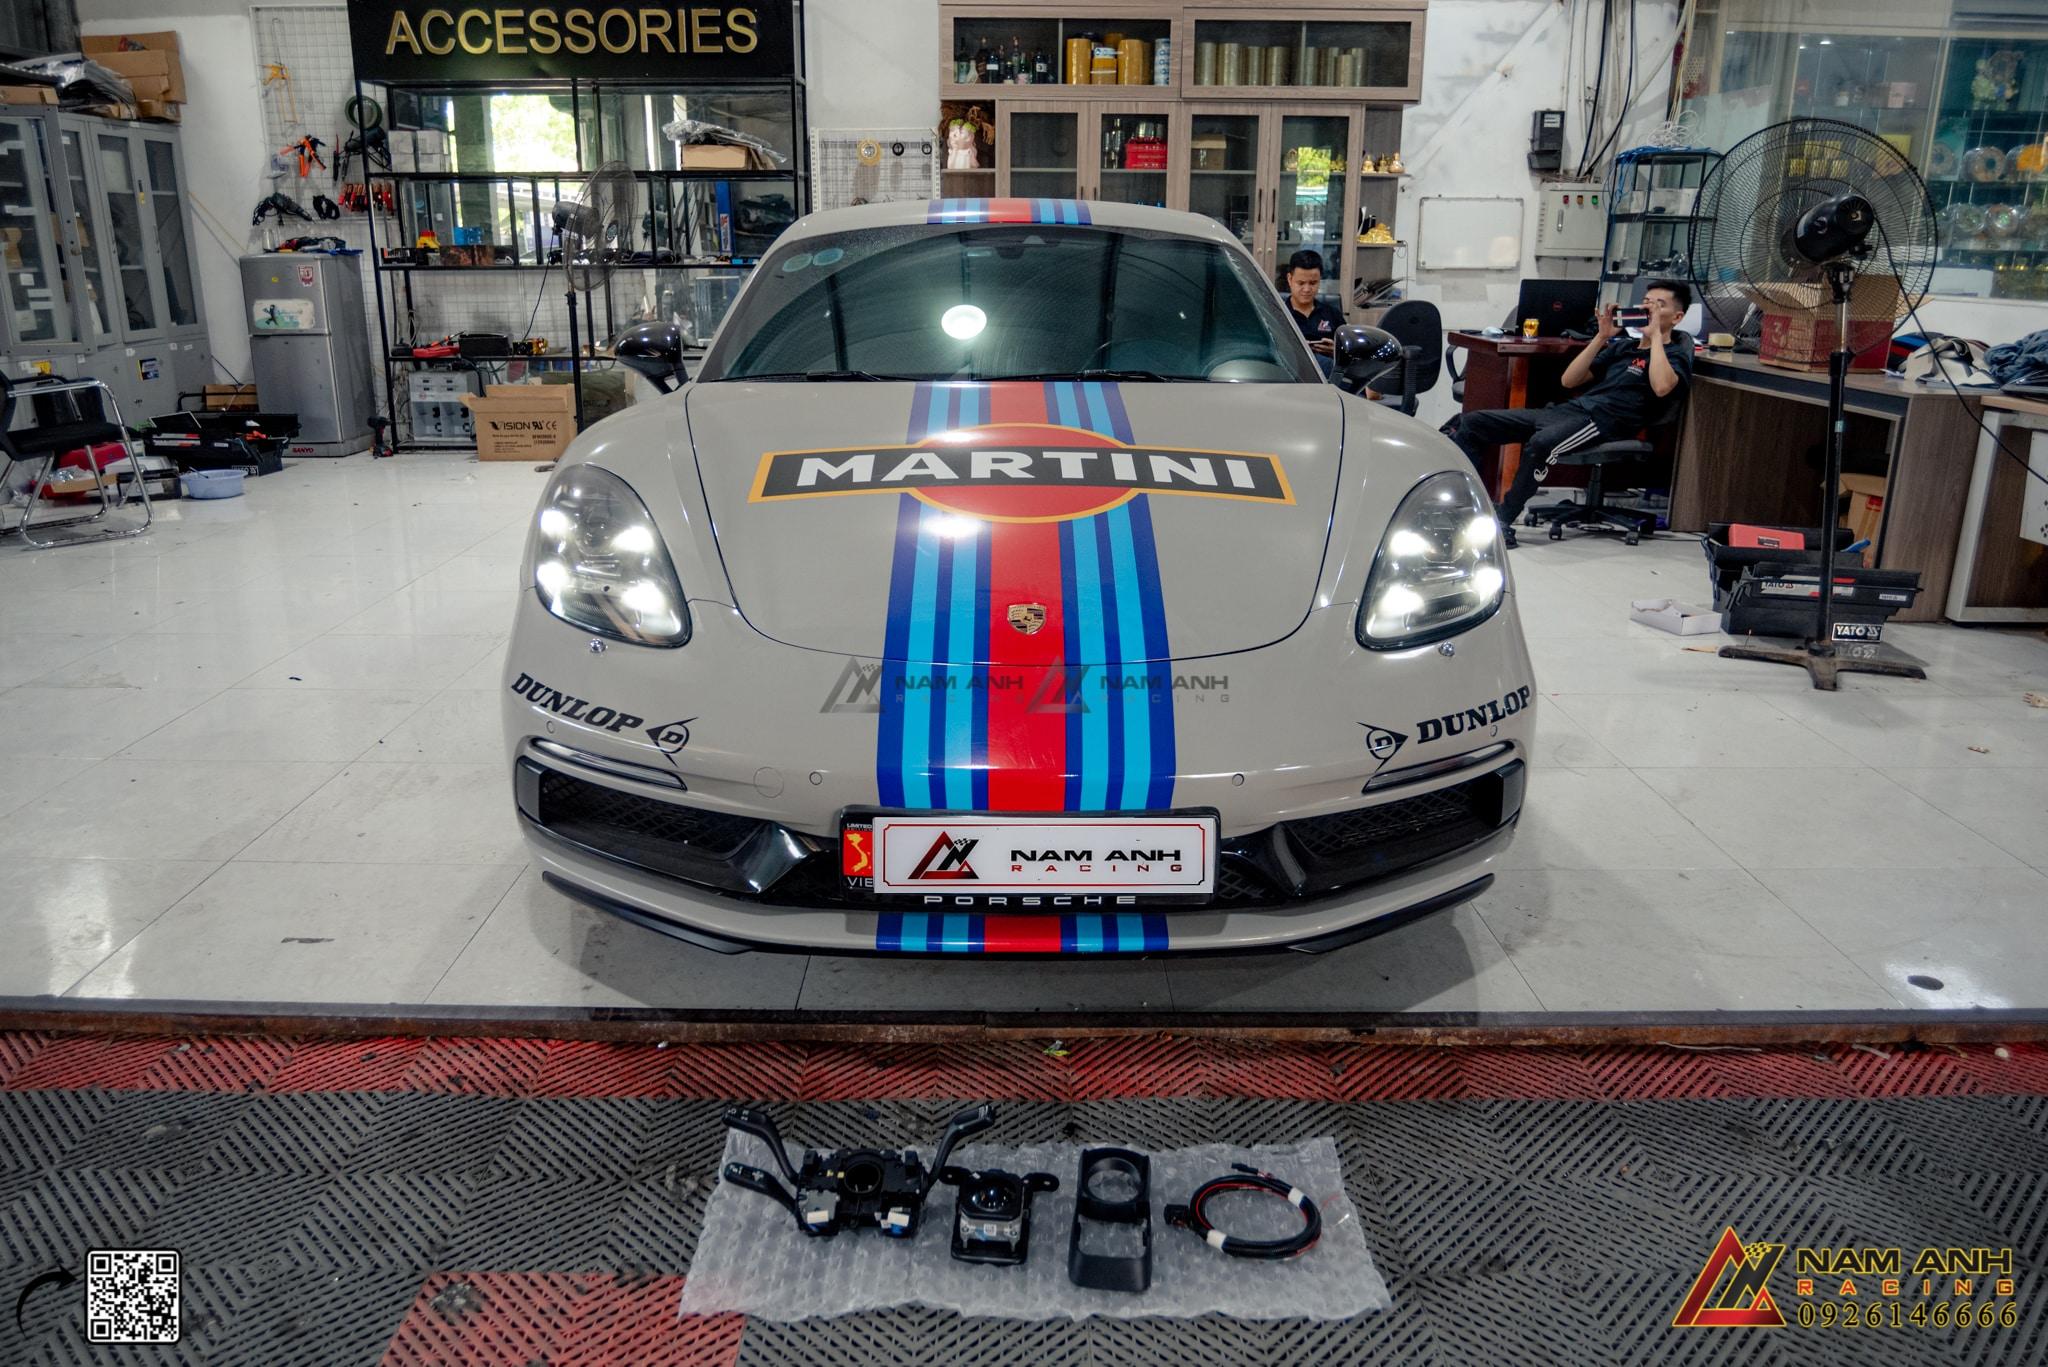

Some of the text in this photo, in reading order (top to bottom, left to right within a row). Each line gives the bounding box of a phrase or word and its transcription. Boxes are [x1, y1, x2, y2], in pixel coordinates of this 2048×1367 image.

[385, 8, 758, 55] ACCESSORIES
[489, 421, 530, 430] VISION
[797, 451, 1255, 489] MARTINI
[1836, 625, 1865, 636] YATO
[511, 672, 644, 732] DUNLOP
[1416, 685, 1531, 744] DUNLOP
[1011, 850, 1181, 861] NAM ANH
[924, 895, 1136, 905] PORSCHE
